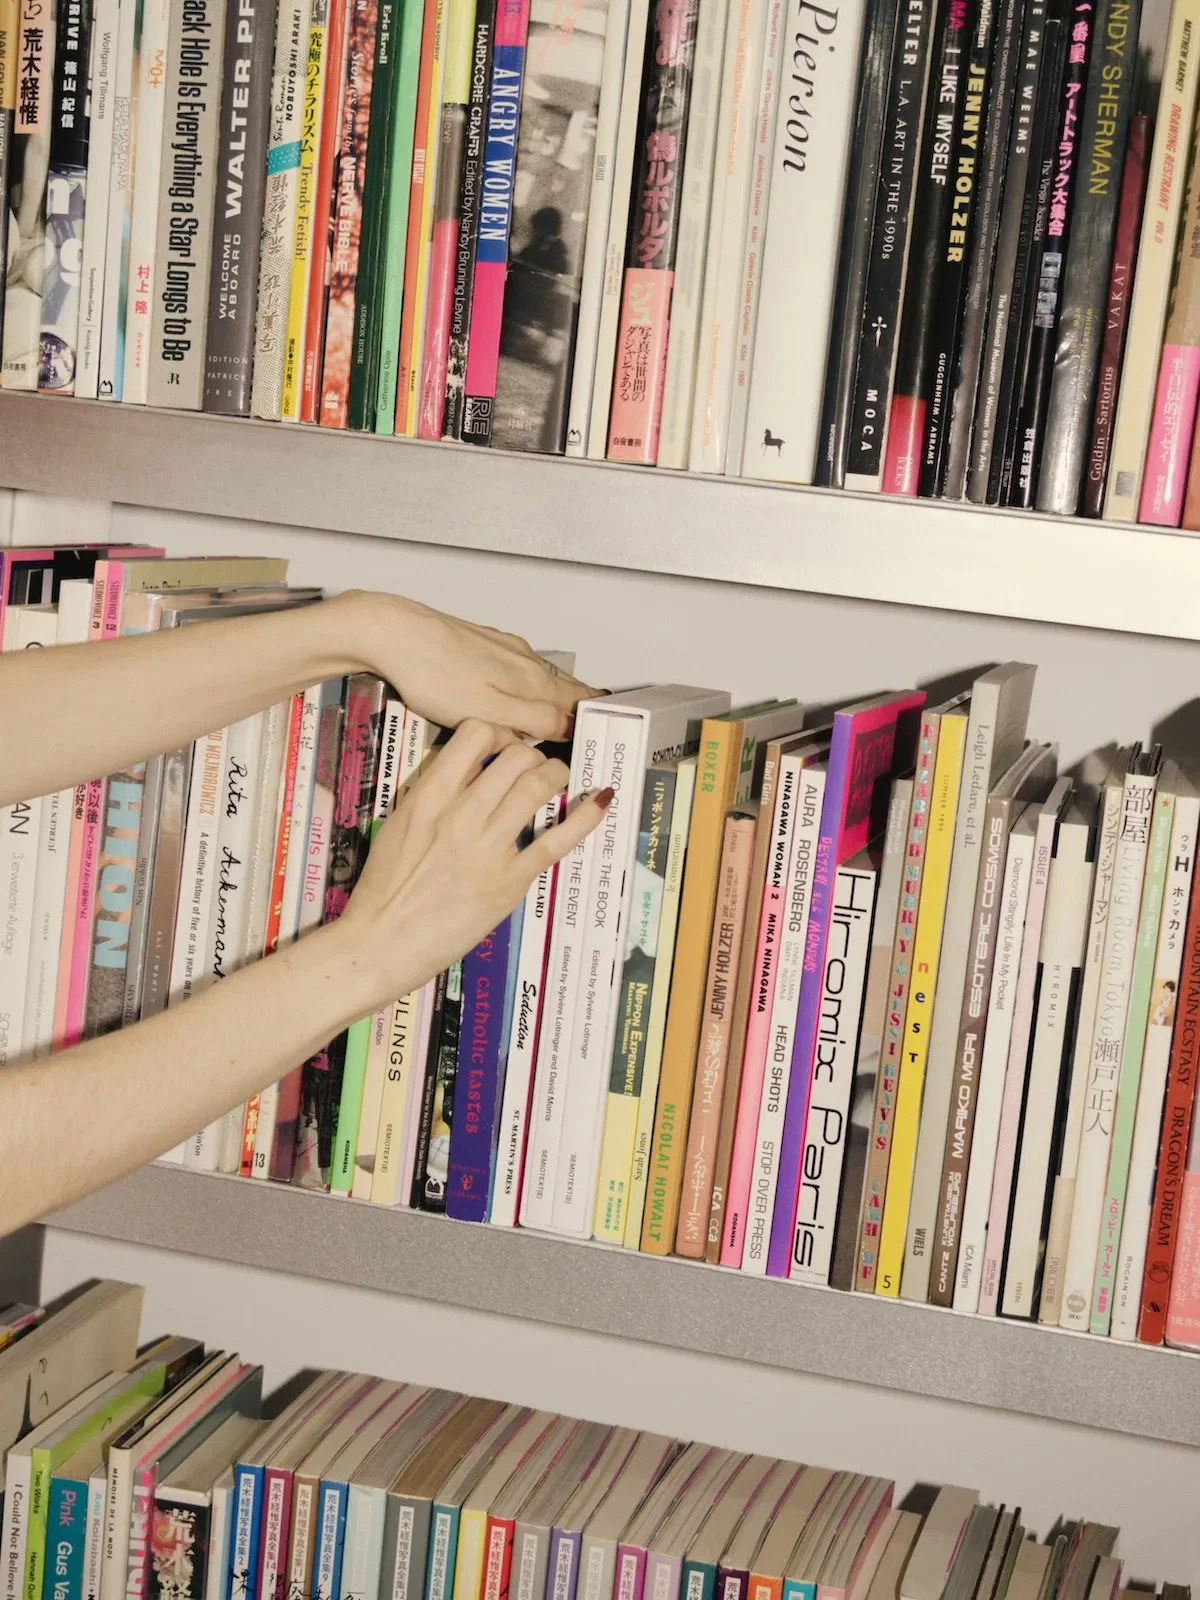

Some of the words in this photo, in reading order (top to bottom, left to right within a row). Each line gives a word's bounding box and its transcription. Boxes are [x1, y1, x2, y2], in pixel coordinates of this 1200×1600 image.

[98, 32, 111, 78] Wolfgang
[179, 37, 210, 77] Hole
[285, 47, 298, 121] NOBUYOSHI
[293, 9, 302, 47] ARAKI
[468, 23, 489, 105] HARDCORE
[1026, 30, 1041, 71] MAE
[19, 27, 43, 125] 荒木経惟
[60, 60, 78, 128] 篠山紀信
[177, 80, 208, 98] Is
[301, 31, 323, 154] 究極のチラリズム
[350, 51, 364, 104] Stories
[783, 0, 839, 173] Pierson
[939, 64, 959, 104] LIKE
[97, 80, 109, 120] Tillmans
[487, 67, 520, 147] ANGRY
[960, 62, 987, 151] JENNY
[1015, 84, 1034, 155] WEEMS
[225, 59, 252, 219] WALTER
[347, 109, 356, 135] from
[467, 106, 483, 157] CRAFTS
[1088, 64, 1123, 195] SHERMAN
[1167, 102, 1182, 156] DRAWING
[168, 101, 206, 198] Everything
[345, 136, 354, 153] the
[930, 113, 955, 187] MYSELF
[1047, 82, 1083, 237] アートトラック大集合
[339, 156, 357, 218] NERVE
[464, 160, 477, 195] Edited
[1042, 159, 1053, 175] The
[1159, 157, 1177, 213] RESTRAINT
[171, 201, 193, 213] a
[462, 196, 474, 210] by
[480, 157, 514, 241] WOMEN
[946, 156, 975, 263] HOLZER
[1037, 178, 1049, 204] Virgin
[168, 218, 199, 258] Star
[458, 212, 474, 249] Nancy
[1033, 206, 1047, 241] Suicides
[335, 220, 351, 273] BIBLE
[162, 261, 196, 314] Longs
[218, 233, 232, 320] WELCOME
[228, 234, 241, 320] ABOARD
[455, 250, 470, 295] Bruning
[452, 297, 466, 334] Levine
[998, 294, 1007, 309] The
[1107, 262, 1126, 330] VAKAT
[164, 317, 191, 336] to
[993, 311, 1004, 347] National
[161, 339, 191, 362] Be
[989, 349, 1000, 383] Museum
[932, 352, 946, 416] GUGGENHEIM
[988, 385, 995, 395] of
[463, 397, 474, 434] SEARCH
[860, 388, 878, 452] MOCA
[984, 396, 994, 428] Women
[1089, 437, 1105, 481] Goldin
[1097, 366, 1114, 425] Sartorius
[927, 426, 937, 465] ABRAMS
[978, 455, 987, 472] Arts
[981, 440, 990, 453] the
[384, 715, 398, 779] NINAGAWA
[973, 723, 989, 760] Leigh
[702, 740, 720, 793] BOXER
[227, 756, 248, 818] Rita
[379, 782, 391, 809] MEN
[779, 770, 794, 837] NINAGAWA
[800, 783, 818, 829] AURA
[967, 765, 985, 813] Ledare,
[966, 817, 976, 829] et
[1120, 784, 1152, 847] 部屋
[964, 833, 976, 848] al.
[773, 840, 785, 889] WOMAN
[815, 836, 832, 886] DESTROY
[1011, 857, 1023, 897] Diamond
[771, 892, 780, 900] 2
[788, 839, 812, 933] ROSENBERG
[811, 889, 823, 913] ALL
[765, 912, 777, 943] MIKA
[968, 912, 991, 1018] ESOTERIC
[981, 817, 1003, 908] COSMOS
[561, 946, 572, 972] Edited
[590, 949, 601, 976] Edited
[715, 922, 734, 975] HOLZER
[1003, 936, 1013, 952] Life
[559, 973, 568, 983] by
[588, 977, 597, 988] by
[757, 945, 771, 1012] NINAGAWA
[814, 871, 871, 1084] Hiromix
[997, 964, 1010, 979] My
[515, 980, 536, 1051] Seduction
[556, 985, 567, 1015] Sylvère
[584, 990, 596, 1021] Sylvère
[711, 976, 728, 1021] JENNY
[995, 980, 1007, 1011] Pocket
[1047, 963, 1060, 1029] HIROMIX
[552, 1017, 564, 1053] Lotringer
[580, 1022, 592, 1060] Lotringer
[774, 1025, 789, 1067] HEAD
[550, 1053, 559, 1069] and
[547, 1071, 557, 1095] David
[767, 1069, 782, 1114] SHOTS
[952, 1084, 970, 1159] MARIKO
[961, 1032, 977, 1081] MORI
[544, 1095, 554, 1122] Morris
[657, 1103, 676, 1168] NICOLAI
[1165, 1105, 1186, 1188] DRAGON'S
[255, 1152, 266, 1169] 13
[762, 1140, 775, 1175] STOP
[648, 1170, 668, 1242] HOWALT
[757, 1178, 771, 1214] OVER
[793, 1105, 843, 1268] Paris
[1158, 1188, 1175, 1248] DREAM
[749, 1217, 765, 1261] PRESS
[913, 1227, 926, 1257] WIELS
[882, 1275, 891, 1289] 5
[35, 1470, 43, 1488] Two
[12, 1493, 23, 1524] Could
[33, 1488, 41, 1515] Works
[59, 1489, 77, 1527] Pink
[110, 1508, 116, 1519] DE
[9, 1526, 20, 1549] Not
[109, 1521, 114, 1533] LA
[29, 1551, 37, 1581] Hannah
[55, 1541, 73, 1577] Gus
[105, 1535, 114, 1560] MODE
[7, 1550, 19, 1591] Believe
